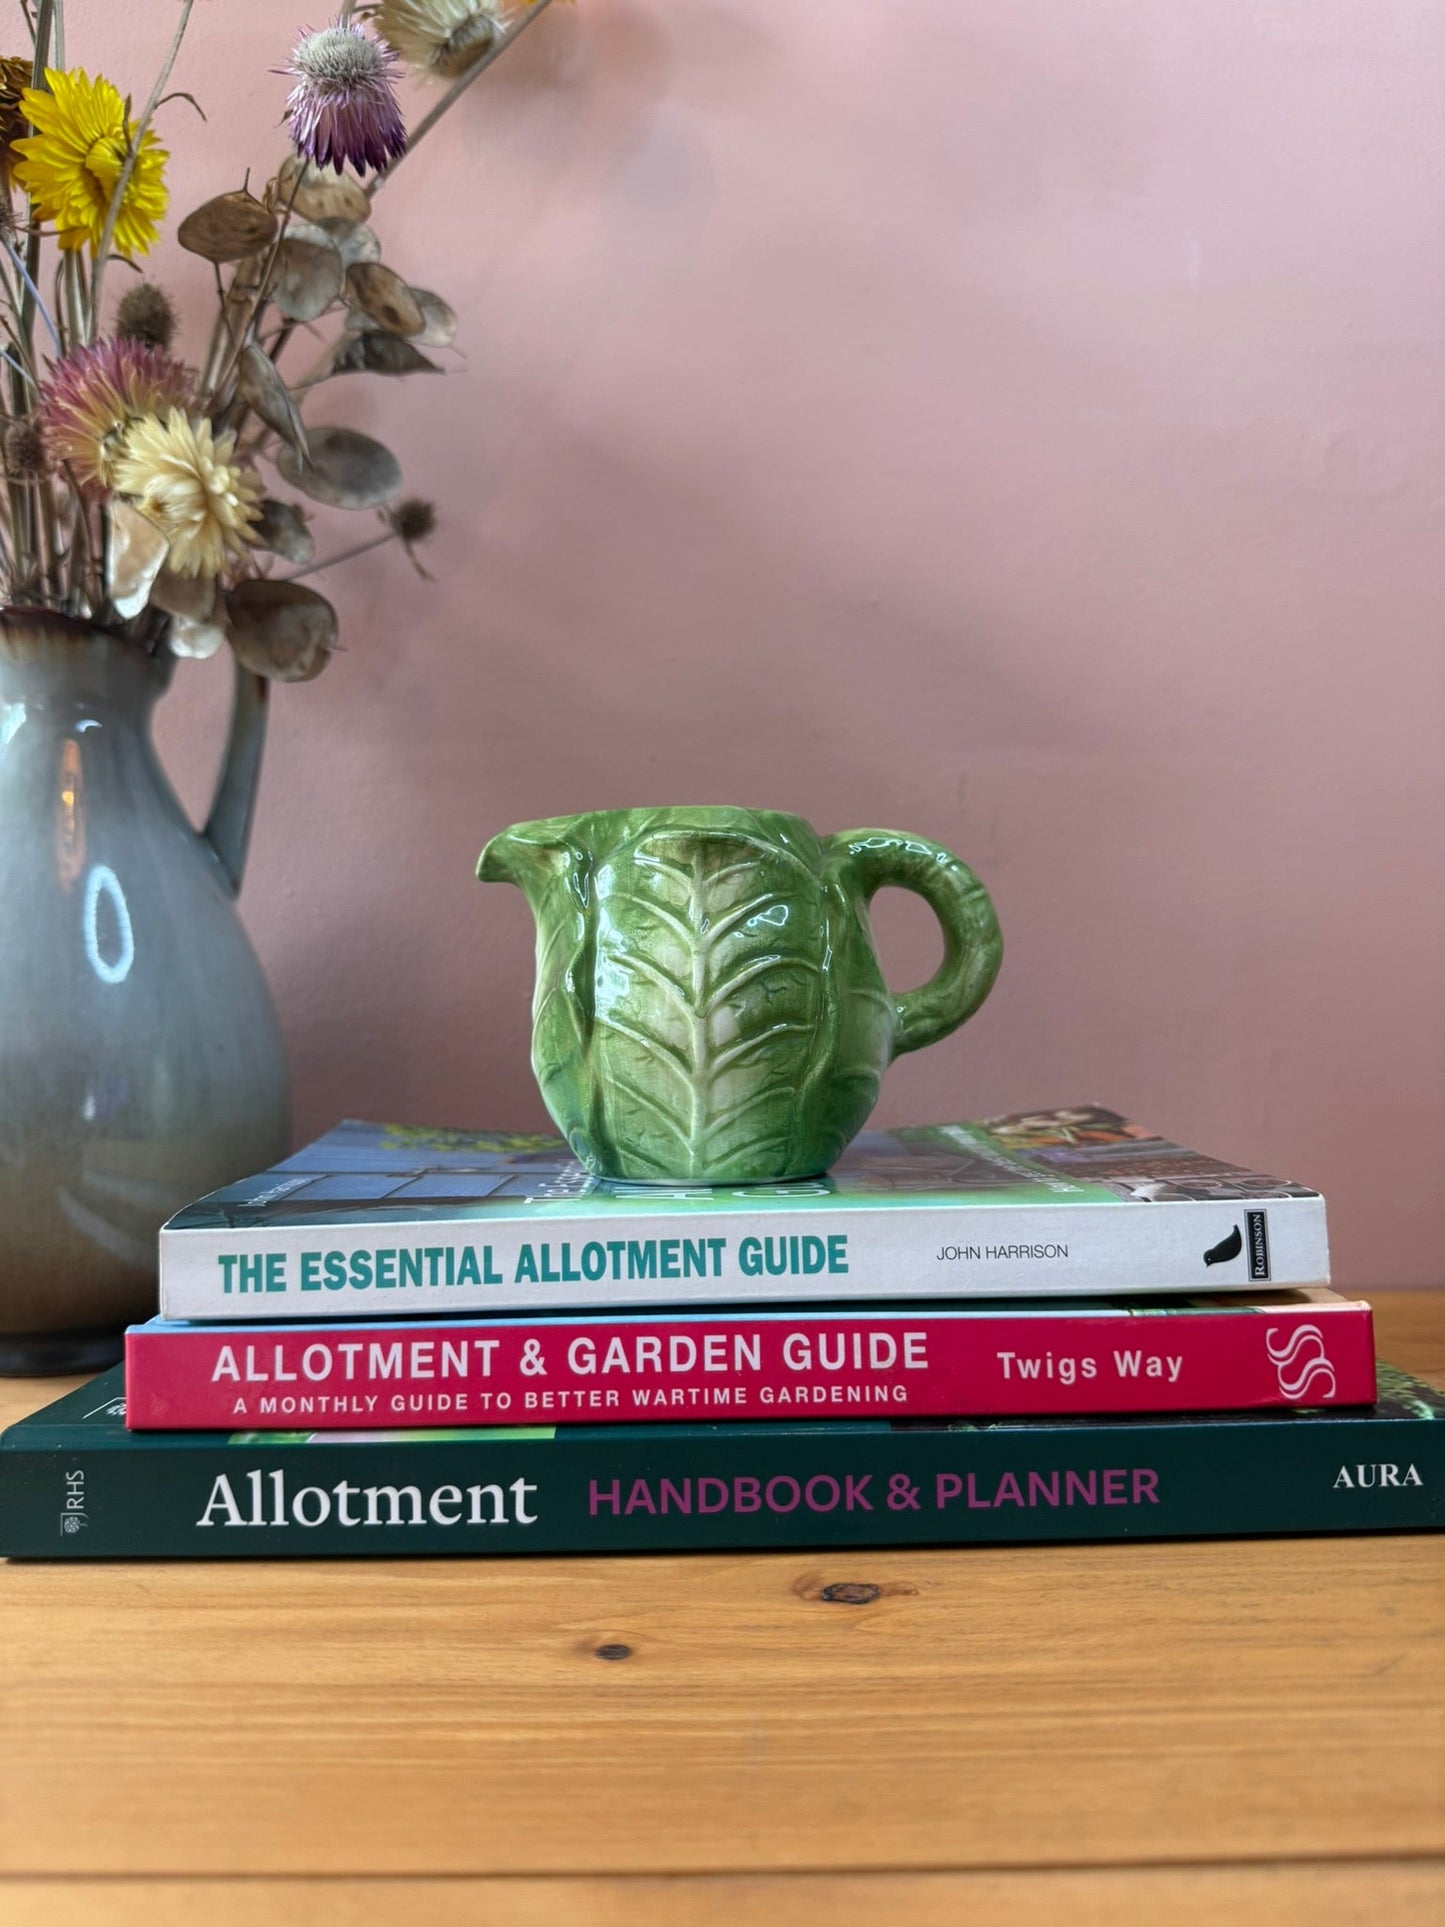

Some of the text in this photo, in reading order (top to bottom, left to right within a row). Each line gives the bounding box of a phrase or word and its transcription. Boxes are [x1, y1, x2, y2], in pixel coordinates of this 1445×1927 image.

[219, 1235, 849, 1293] THE ESSENTIAL ALLOTMENT GUIDE
[936, 1244, 1068, 1260] JOHN HARRISON
[212, 1331, 928, 1383] ALLOTMENT & GARDEN GUIDE
[997, 1350, 1183, 1384] Twigs Way
[233, 1385, 908, 1414] A MONTHLY GUIDE TO BETTER WARTIME GARDENING
[66, 1470, 85, 1509] RHS
[589, 1468, 1160, 1516] HANDBOOK & PLANNER
[1333, 1464, 1423, 1489] AURA
[196, 1470, 538, 1528] Allotment
